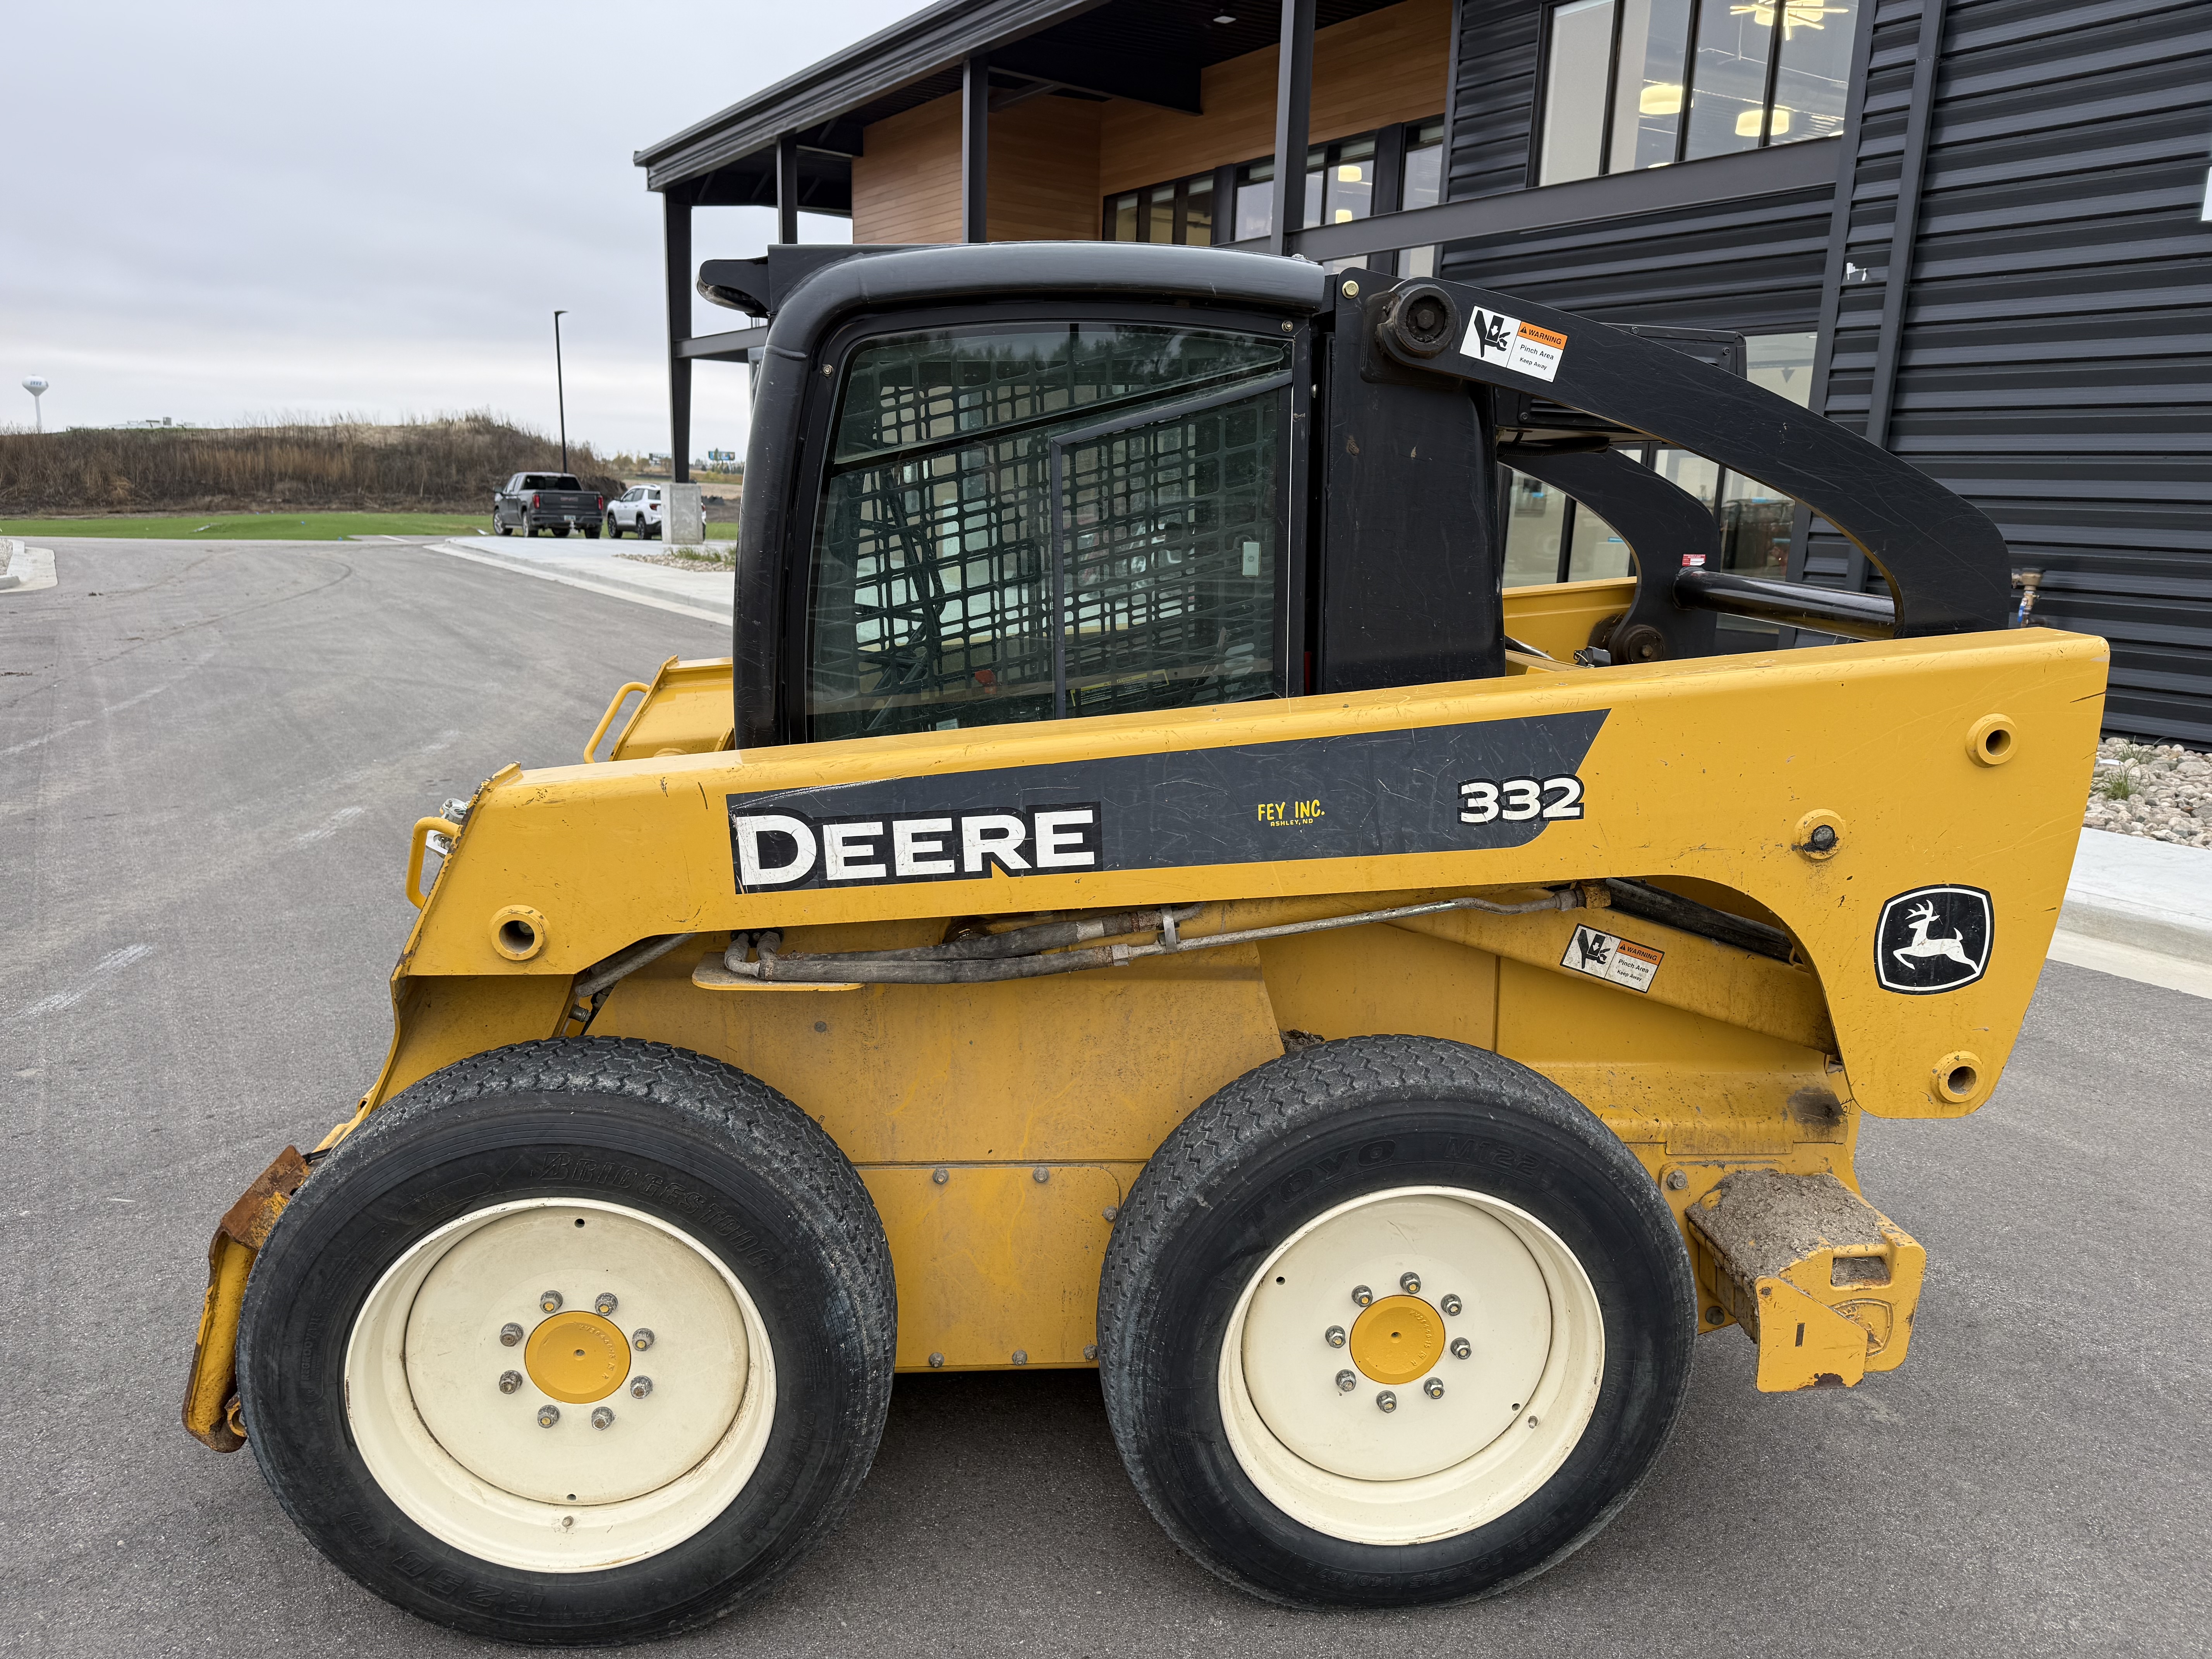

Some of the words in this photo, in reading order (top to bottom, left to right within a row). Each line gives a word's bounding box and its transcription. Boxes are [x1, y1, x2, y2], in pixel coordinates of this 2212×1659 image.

[1529, 329, 1562, 345] WARNING
[1520, 344, 1538, 355] Pinch
[1539, 351, 1554, 360] Area
[1520, 357, 1532, 365] Keep
[1534, 362, 1547, 370] Away
[1258, 801, 1286, 821] FEY
[1295, 799, 1325, 818] INC.
[1460, 777, 1580, 823] 332
[735, 809, 1095, 885] DEERE
[1627, 946, 1657, 960] WARNING
[1618, 959, 1635, 969] Pinch
[1635, 965, 1649, 973] Area
[1444, 1136, 1539, 1178] M122
[1240, 1139, 1396, 1225] TOYO
[539, 1151, 775, 1267] BRIDGESTONE
